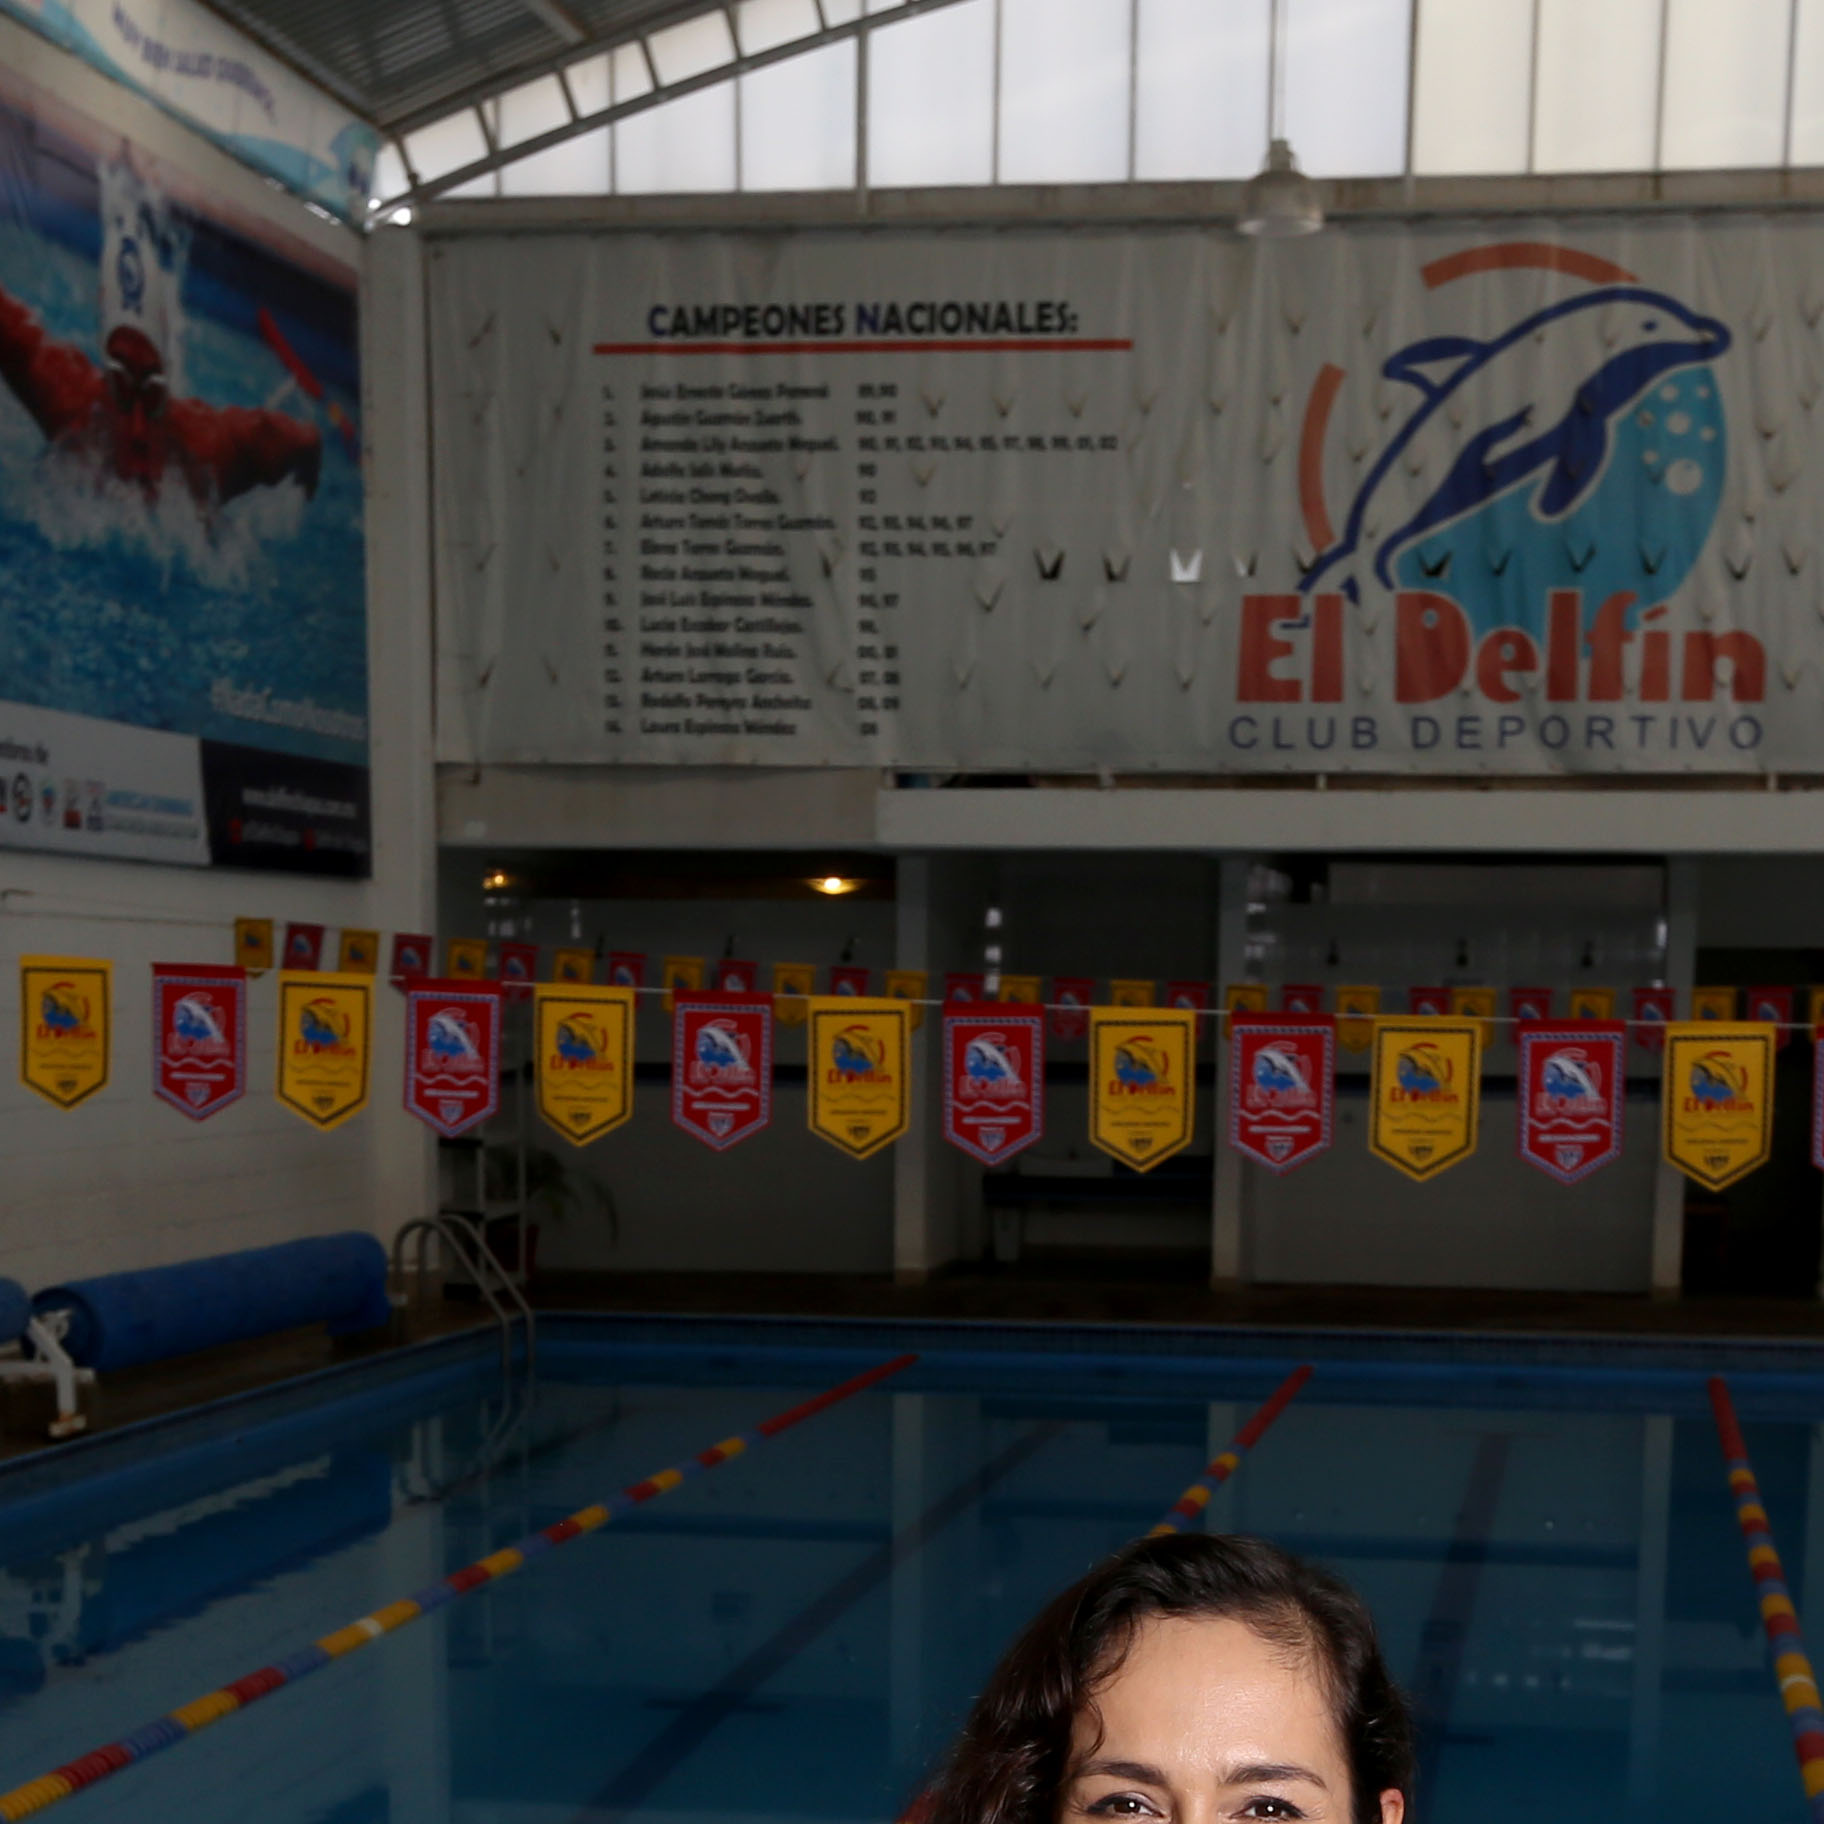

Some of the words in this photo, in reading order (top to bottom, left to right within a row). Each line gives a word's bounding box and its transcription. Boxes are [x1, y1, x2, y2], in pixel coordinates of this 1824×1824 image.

[648, 303, 844, 340] CAMPEONES
[856, 300, 1078, 337] NACIONALES:
[1235, 593, 1343, 703] El
[1227, 715, 1379, 751] CLUB
[1411, 714, 1764, 751] DEPORTIVO
